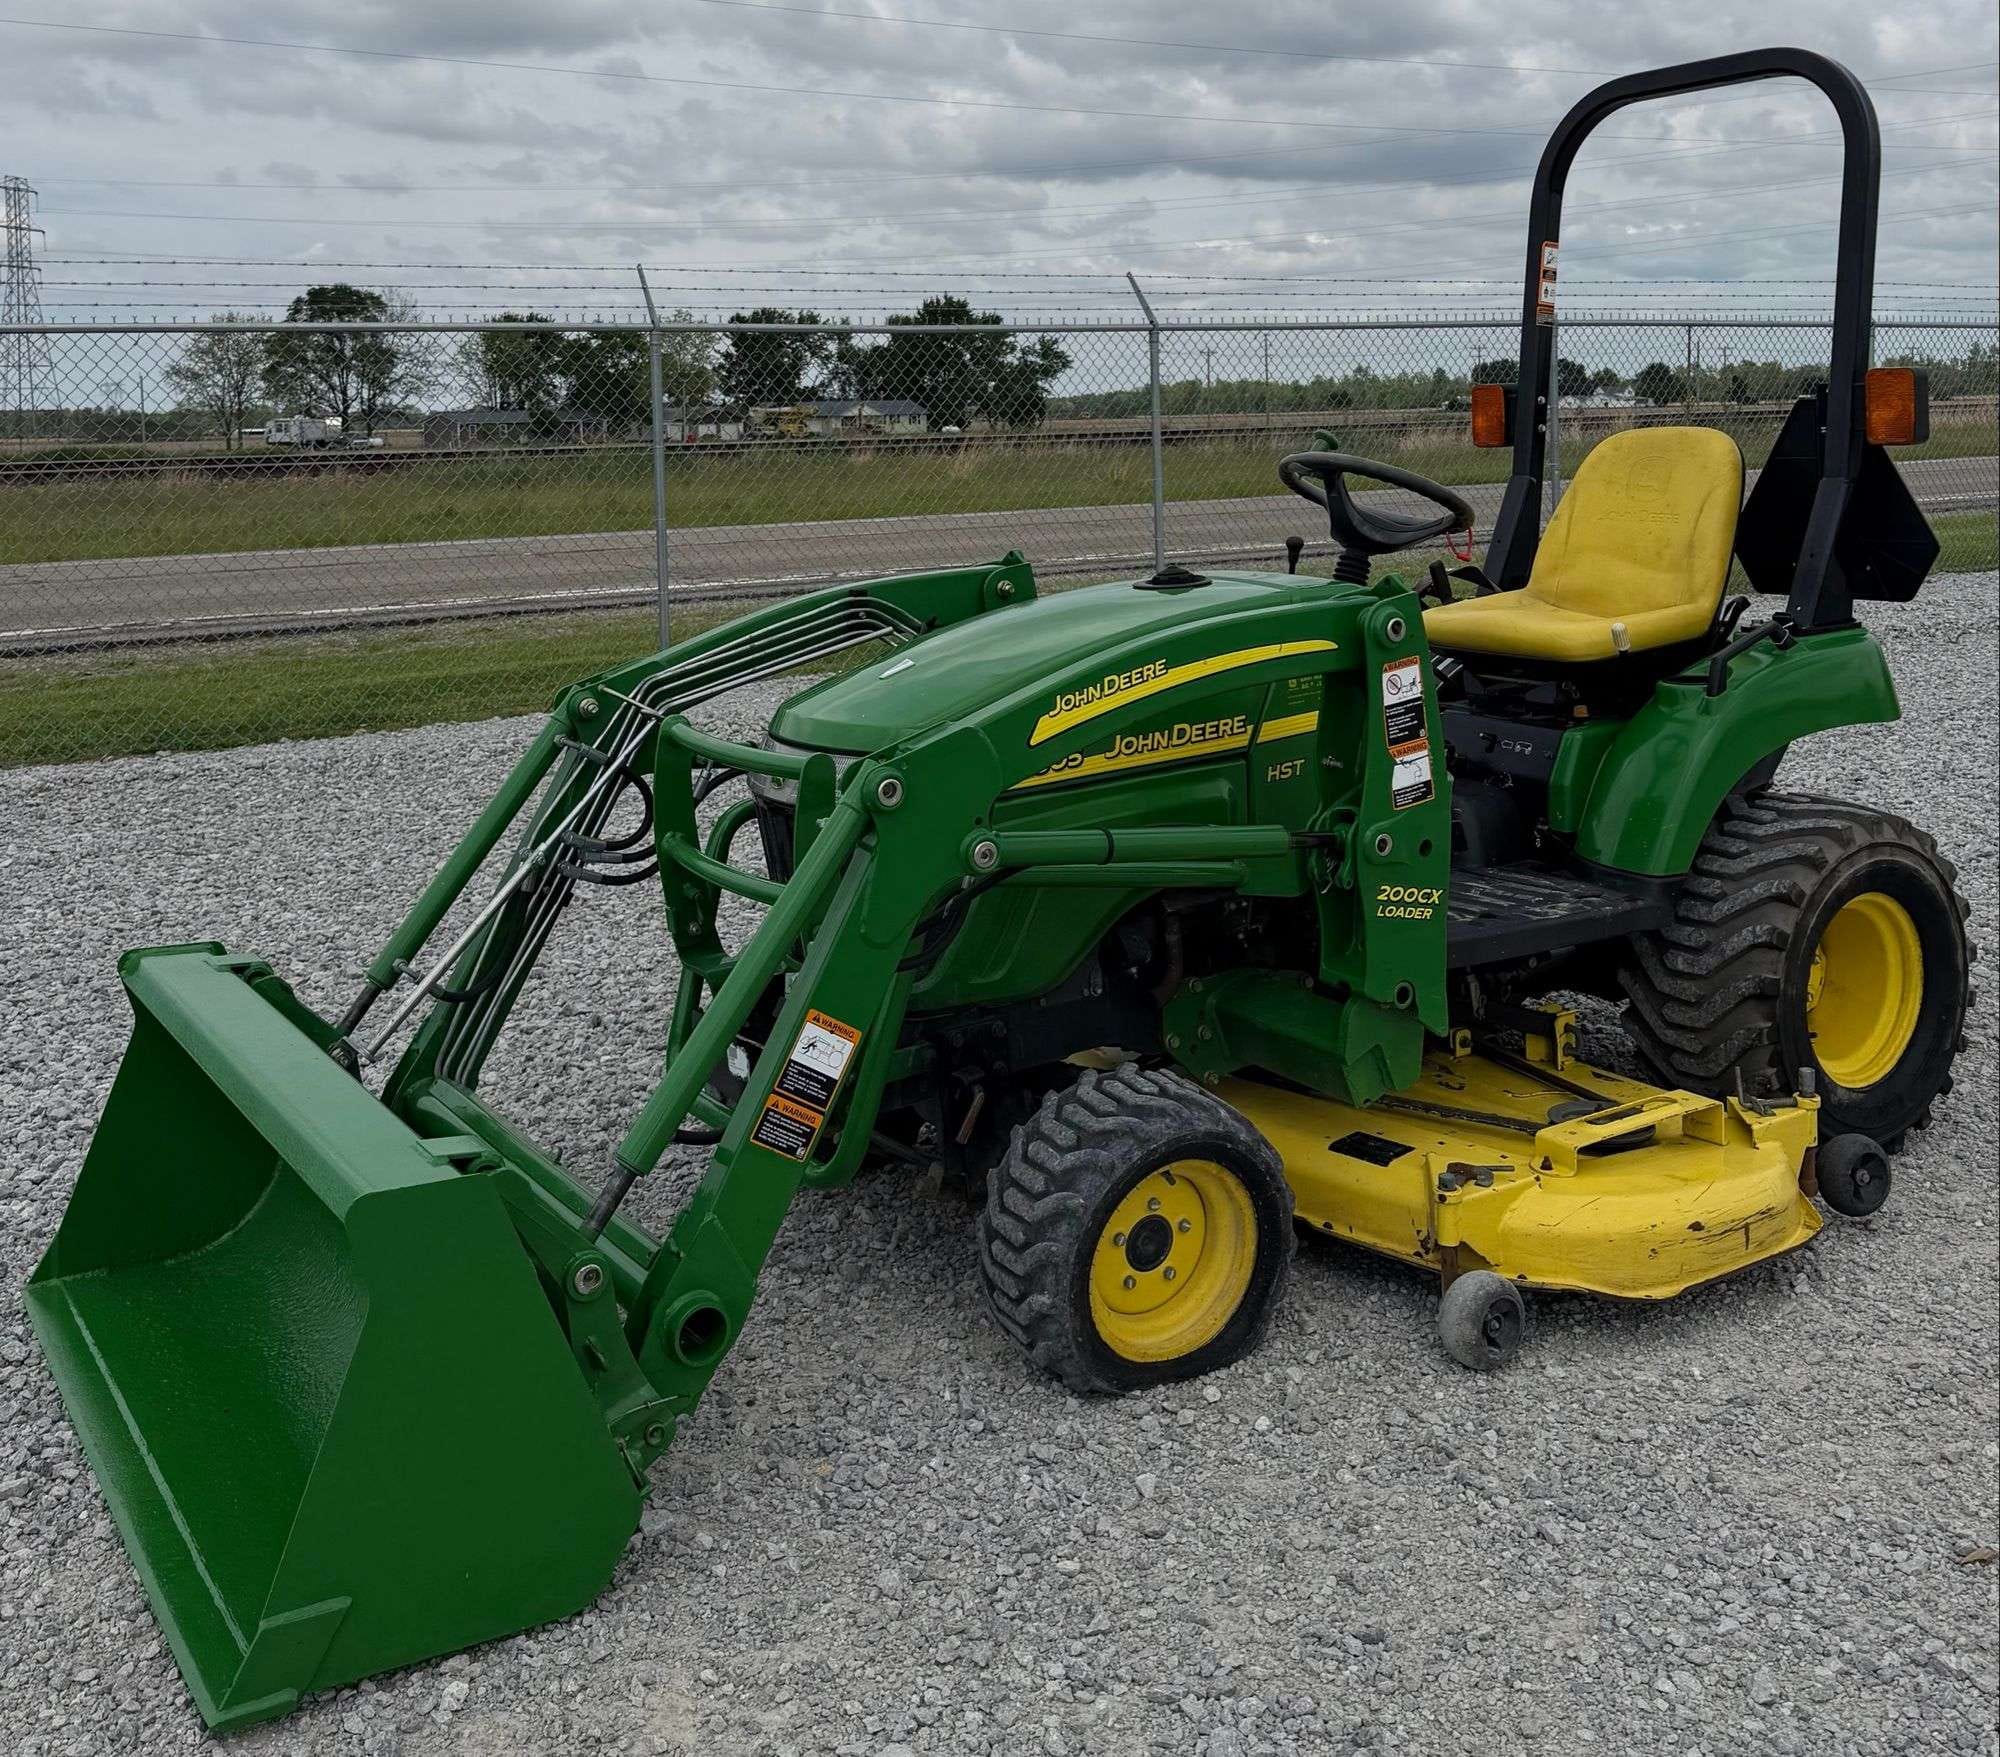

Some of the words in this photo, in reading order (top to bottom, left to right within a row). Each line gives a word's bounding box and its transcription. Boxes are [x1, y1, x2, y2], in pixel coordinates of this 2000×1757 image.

[1387, 656, 1418, 672] WARNING
[1048, 683, 1101, 717] JOHN
[1102, 658, 1168, 697] DEERE
[1104, 730, 1170, 760] JOHN
[1170, 714, 1247, 748] DEERE
[1395, 741, 1427, 758] WARNING
[1267, 759, 1305, 783] HST
[1376, 885, 1444, 904] 200CX
[1376, 905, 1433, 920] LOADER
[821, 1017, 855, 1039] WARNING
[782, 1101, 817, 1124] WARNING
